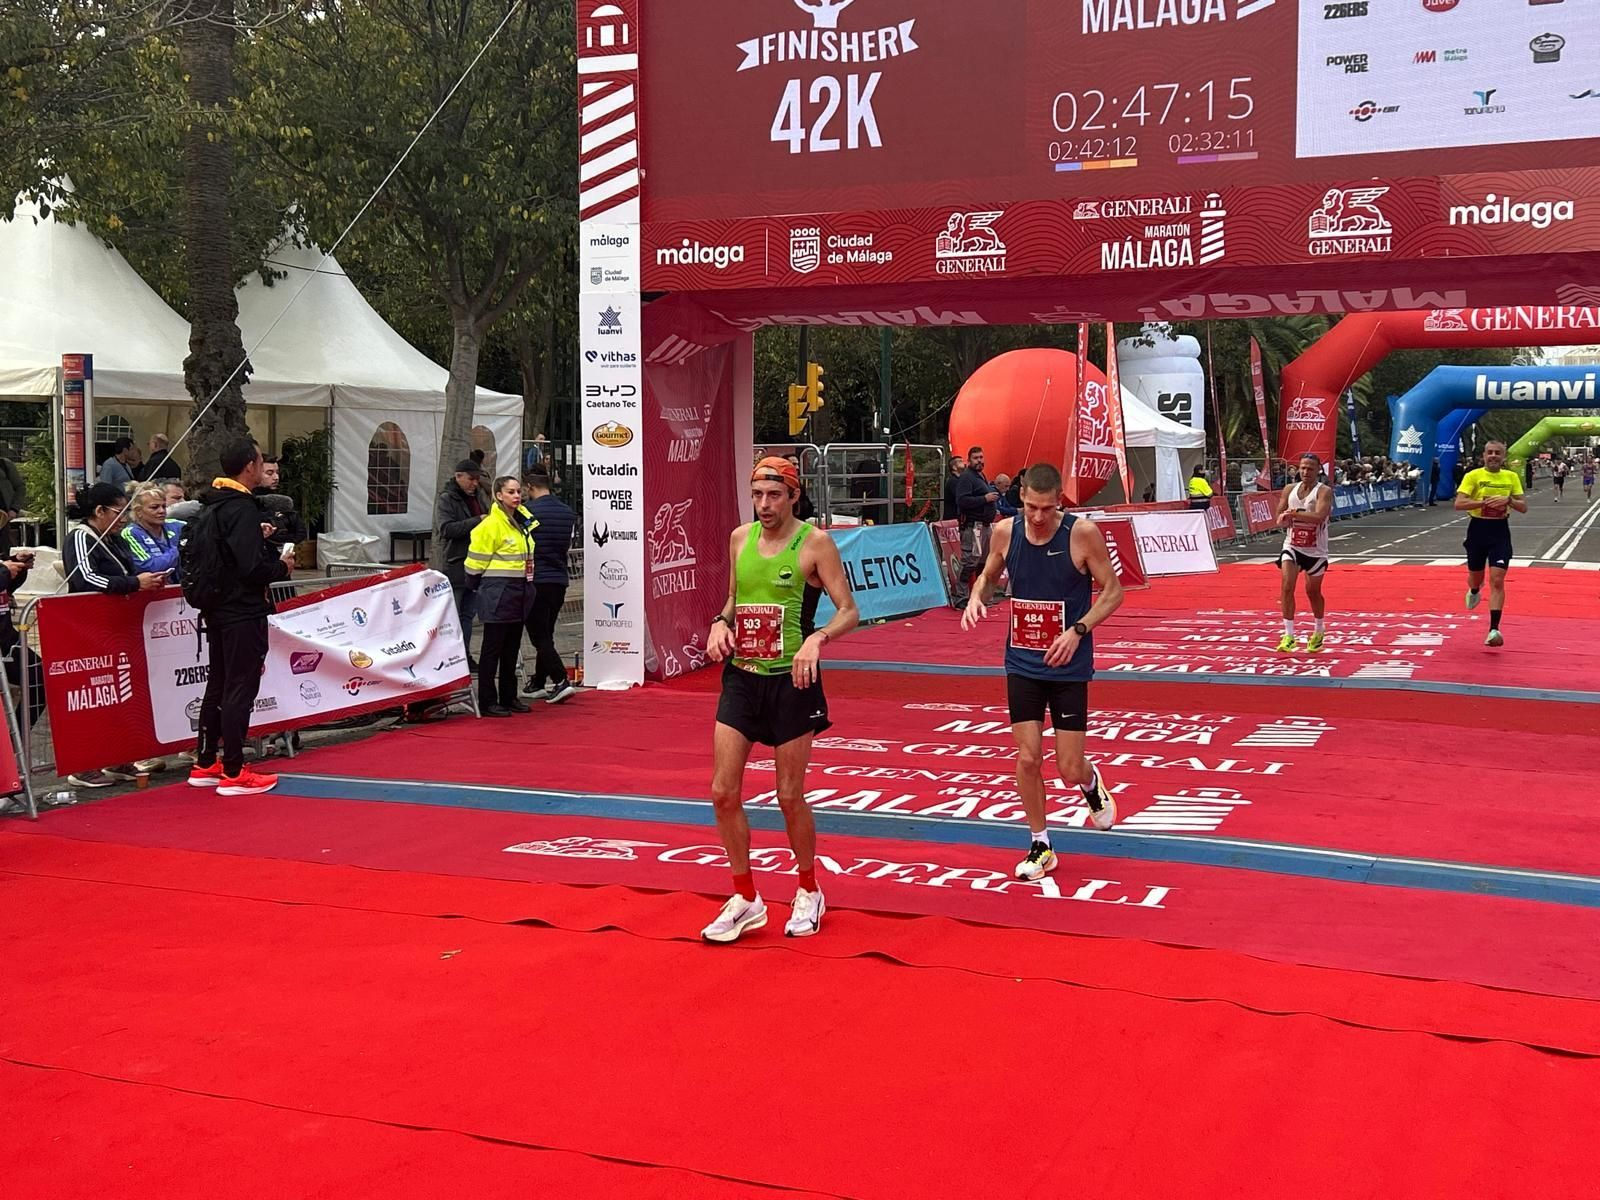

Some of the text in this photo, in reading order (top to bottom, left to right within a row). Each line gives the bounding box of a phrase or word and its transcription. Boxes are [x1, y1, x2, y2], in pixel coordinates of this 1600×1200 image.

[762, 26, 899, 65] FINISHER
[1326, 53, 1368, 66] POWER
[1345, 63, 1368, 74] ADE
[770, 71, 883, 154] 42K
[1052, 77, 1254, 132] 02:47:15
[1049, 136, 1137, 161] 02:42:12
[1169, 129, 1254, 153] 02:32:11
[1101, 196, 1192, 218] GENERALI
[1145, 222, 1191, 239] MARATÓN
[827, 233, 873, 248] Ciudad
[1308, 236, 1392, 256] GENERALI
[827, 248, 893, 265] de Málaga
[1101, 233, 1194, 270] MÁLAGA
[936, 256, 1006, 275] GENERALI
[598, 326, 622, 335] luanvi
[600, 351, 637, 362] vithas
[585, 385, 637, 397] BYD
[1475, 373, 1596, 401] luanvi
[586, 400, 637, 408] Caetano Tec
[1285, 421, 1325, 431] GENERALI
[588, 463, 638, 477] Vitaldin
[592, 490, 632, 500] POWER
[610, 500, 633, 511] ADE
[743, 618, 761, 629] 503
[1024, 613, 1044, 623] 484
[65, 654, 113, 673] GENERALI
[67, 684, 118, 712] MÁLAGA
[657, 844, 1180, 909] GENERALI
